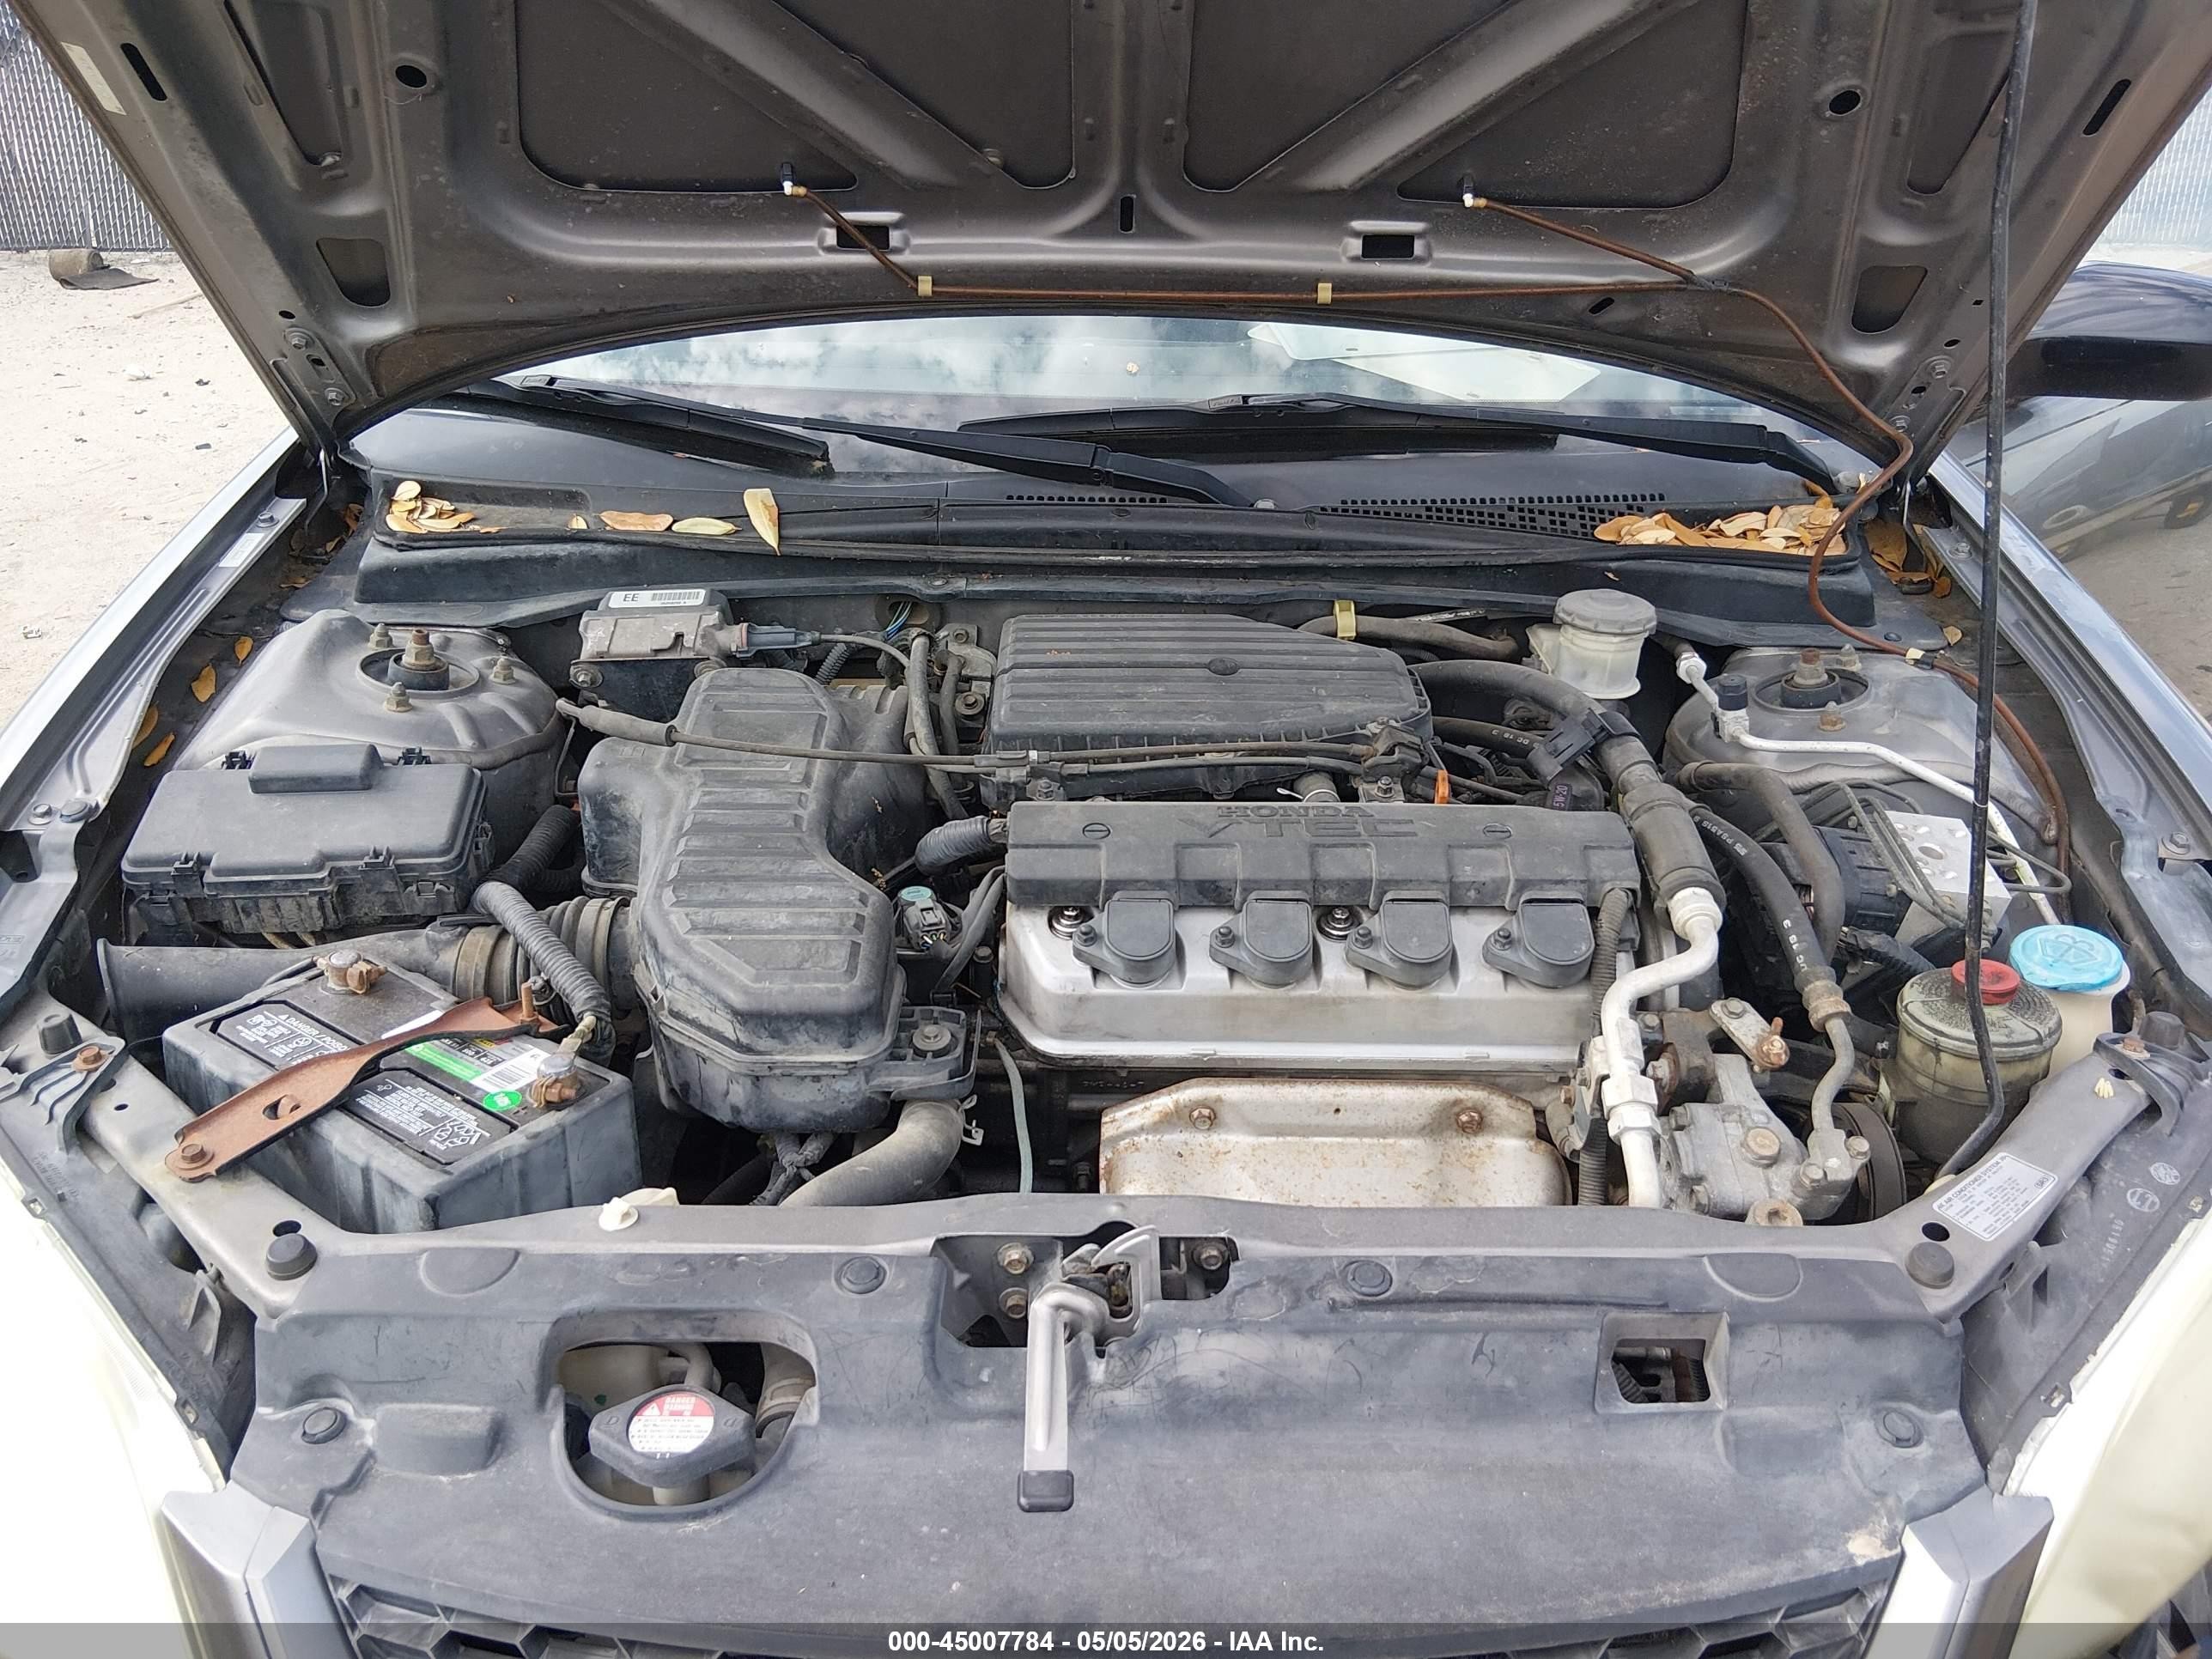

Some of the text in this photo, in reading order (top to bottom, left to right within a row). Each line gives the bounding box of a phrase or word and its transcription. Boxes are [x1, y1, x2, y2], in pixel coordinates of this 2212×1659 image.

[623, 592, 639, 602] EE
[1217, 805, 1375, 817] HONDA
[1176, 818, 1419, 839] VTEC
[286, 1018, 319, 1036] DANGER
[321, 1036, 351, 1052] POISO
